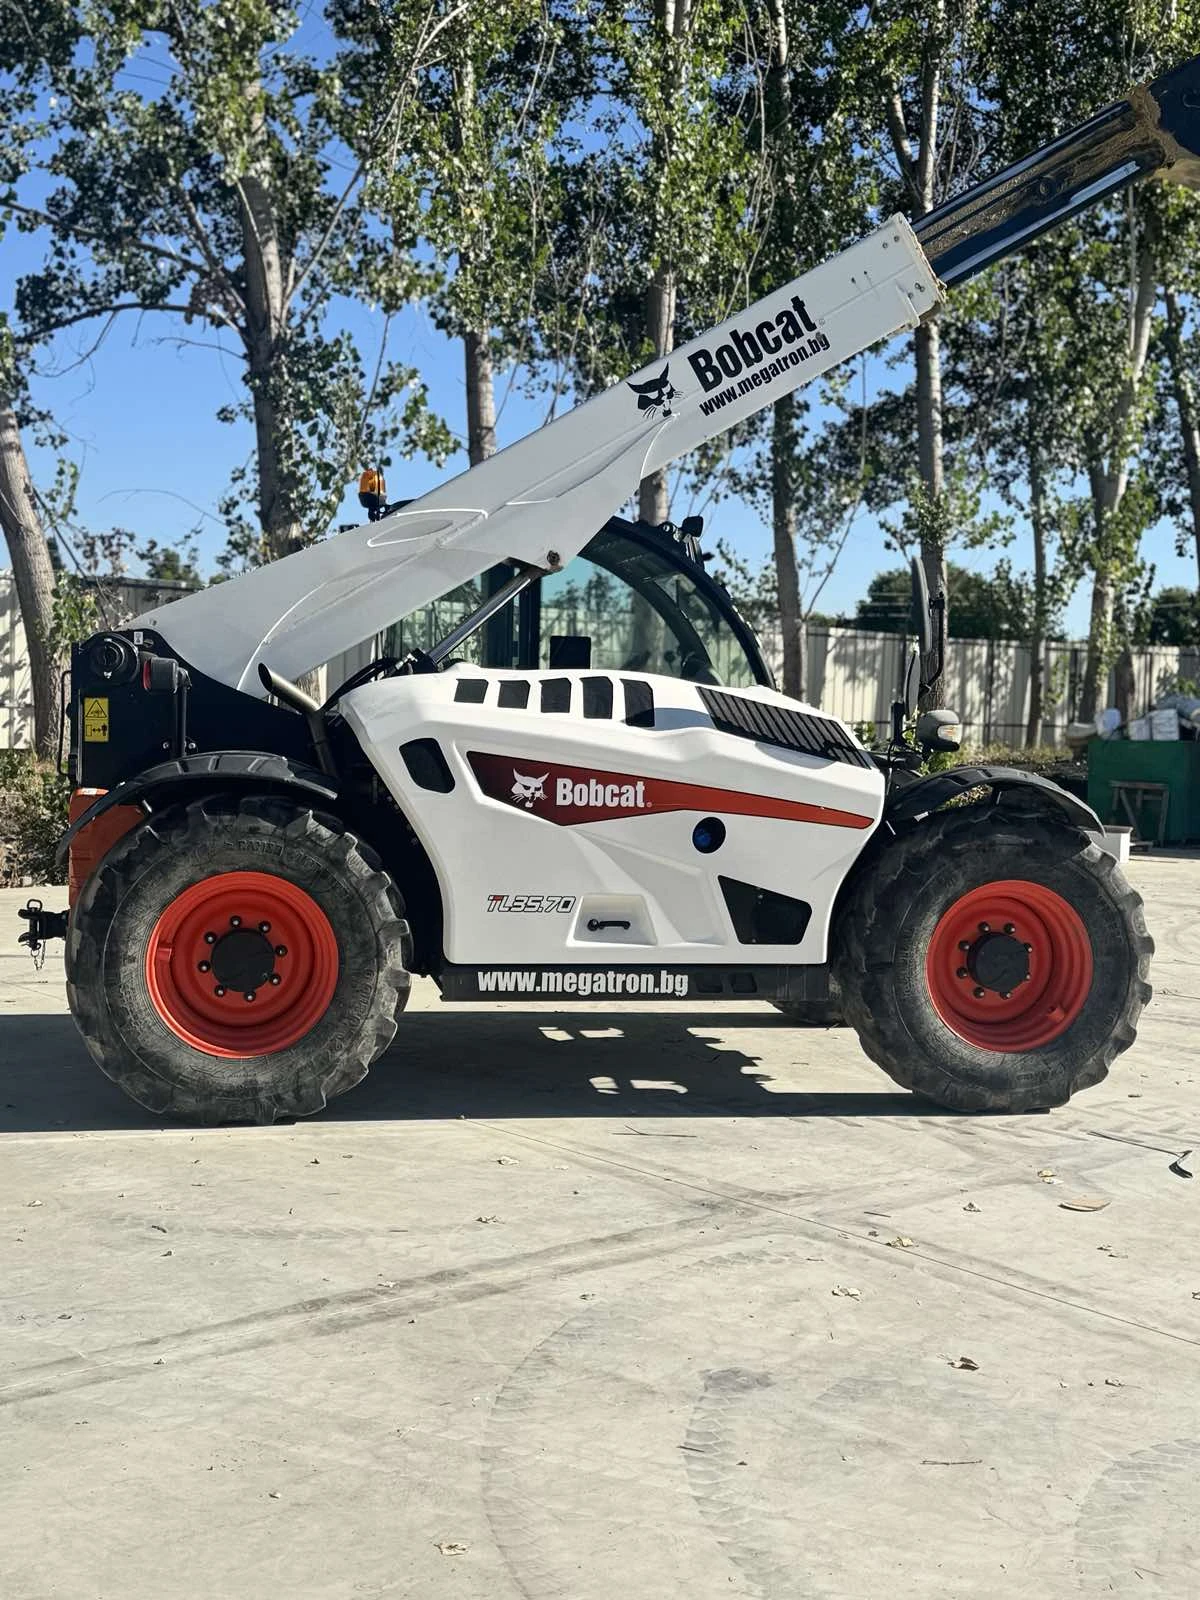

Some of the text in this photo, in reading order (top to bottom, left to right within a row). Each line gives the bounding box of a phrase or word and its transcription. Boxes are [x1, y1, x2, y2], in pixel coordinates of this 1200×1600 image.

[687, 295, 817, 393] Bobcat
[699, 332, 831, 416] www.megatron.bg
[556, 778, 646, 808] Bobcat
[487, 895, 576, 913] TL35.70
[477, 970, 689, 997] www.megatron.bg
